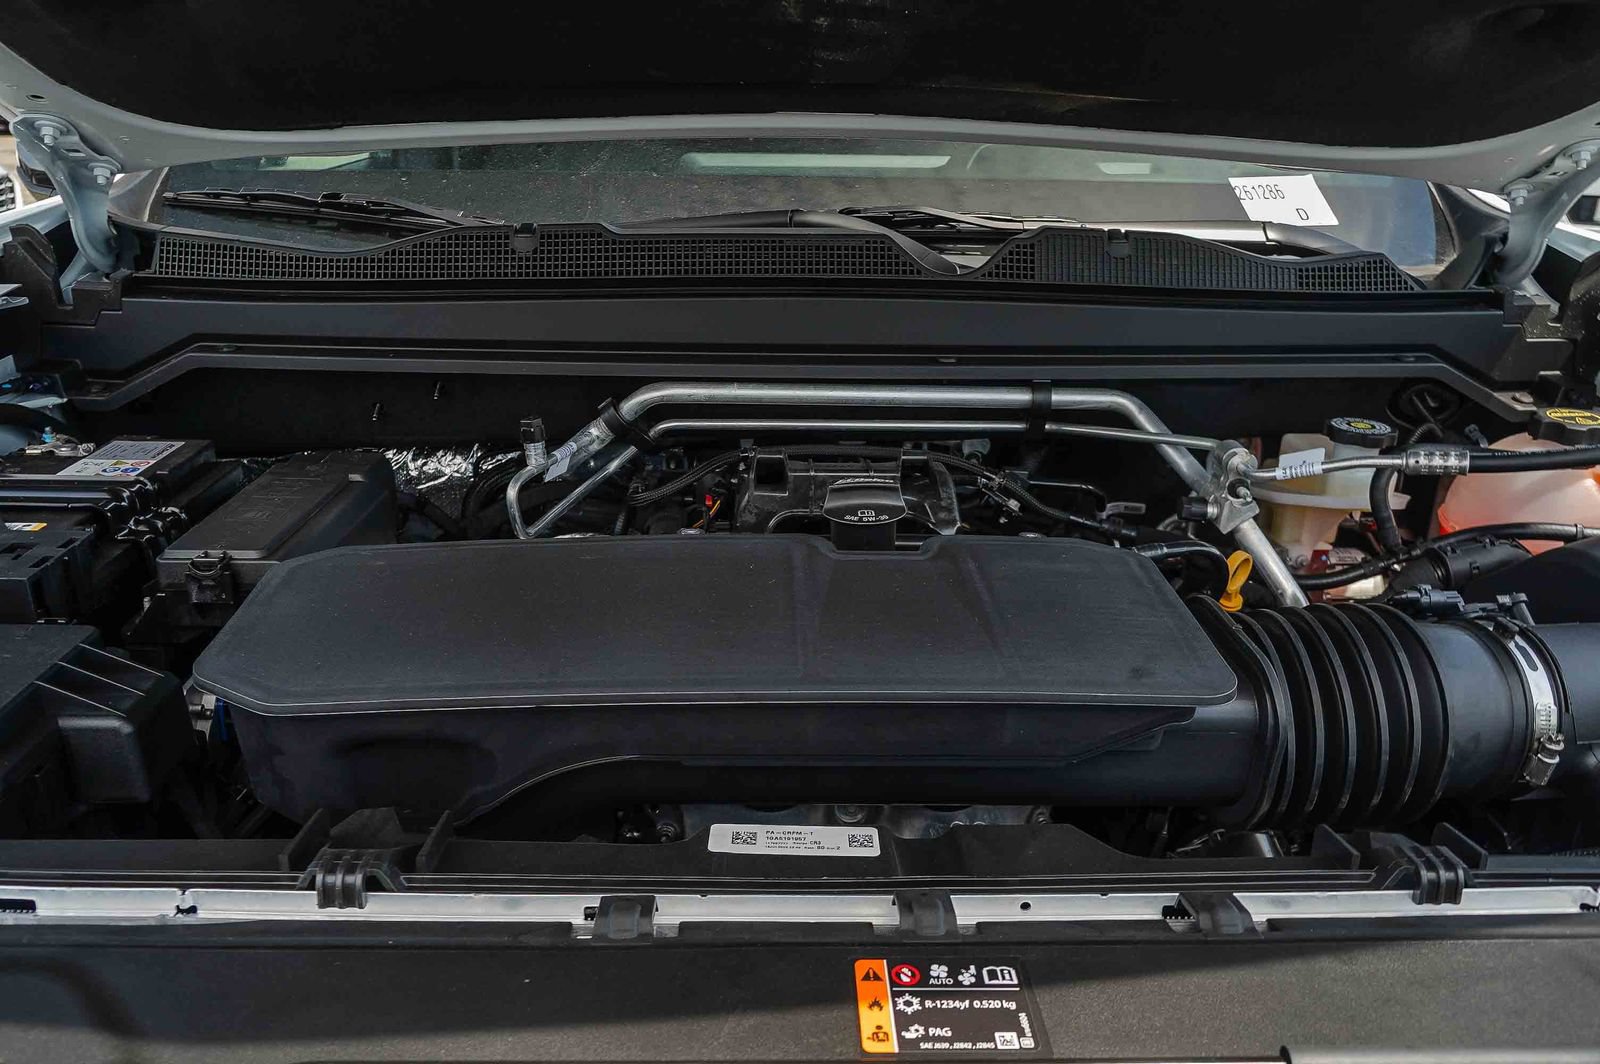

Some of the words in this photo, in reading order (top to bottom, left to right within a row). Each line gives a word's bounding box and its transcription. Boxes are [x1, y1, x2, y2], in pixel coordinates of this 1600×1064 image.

[1234, 184, 1285, 201] 261286
[1296, 208, 1309, 221] D
[844, 514, 859, 522] SAE
[862, 514, 889, 522] 5W-30
[925, 1000, 970, 1009] R-1234yf
[973, 1000, 1001, 1009] 0.520
[1003, 1000, 1017, 1010] kg
[928, 1027, 952, 1037] PAG
[919, 1041, 933, 1049] SAE
